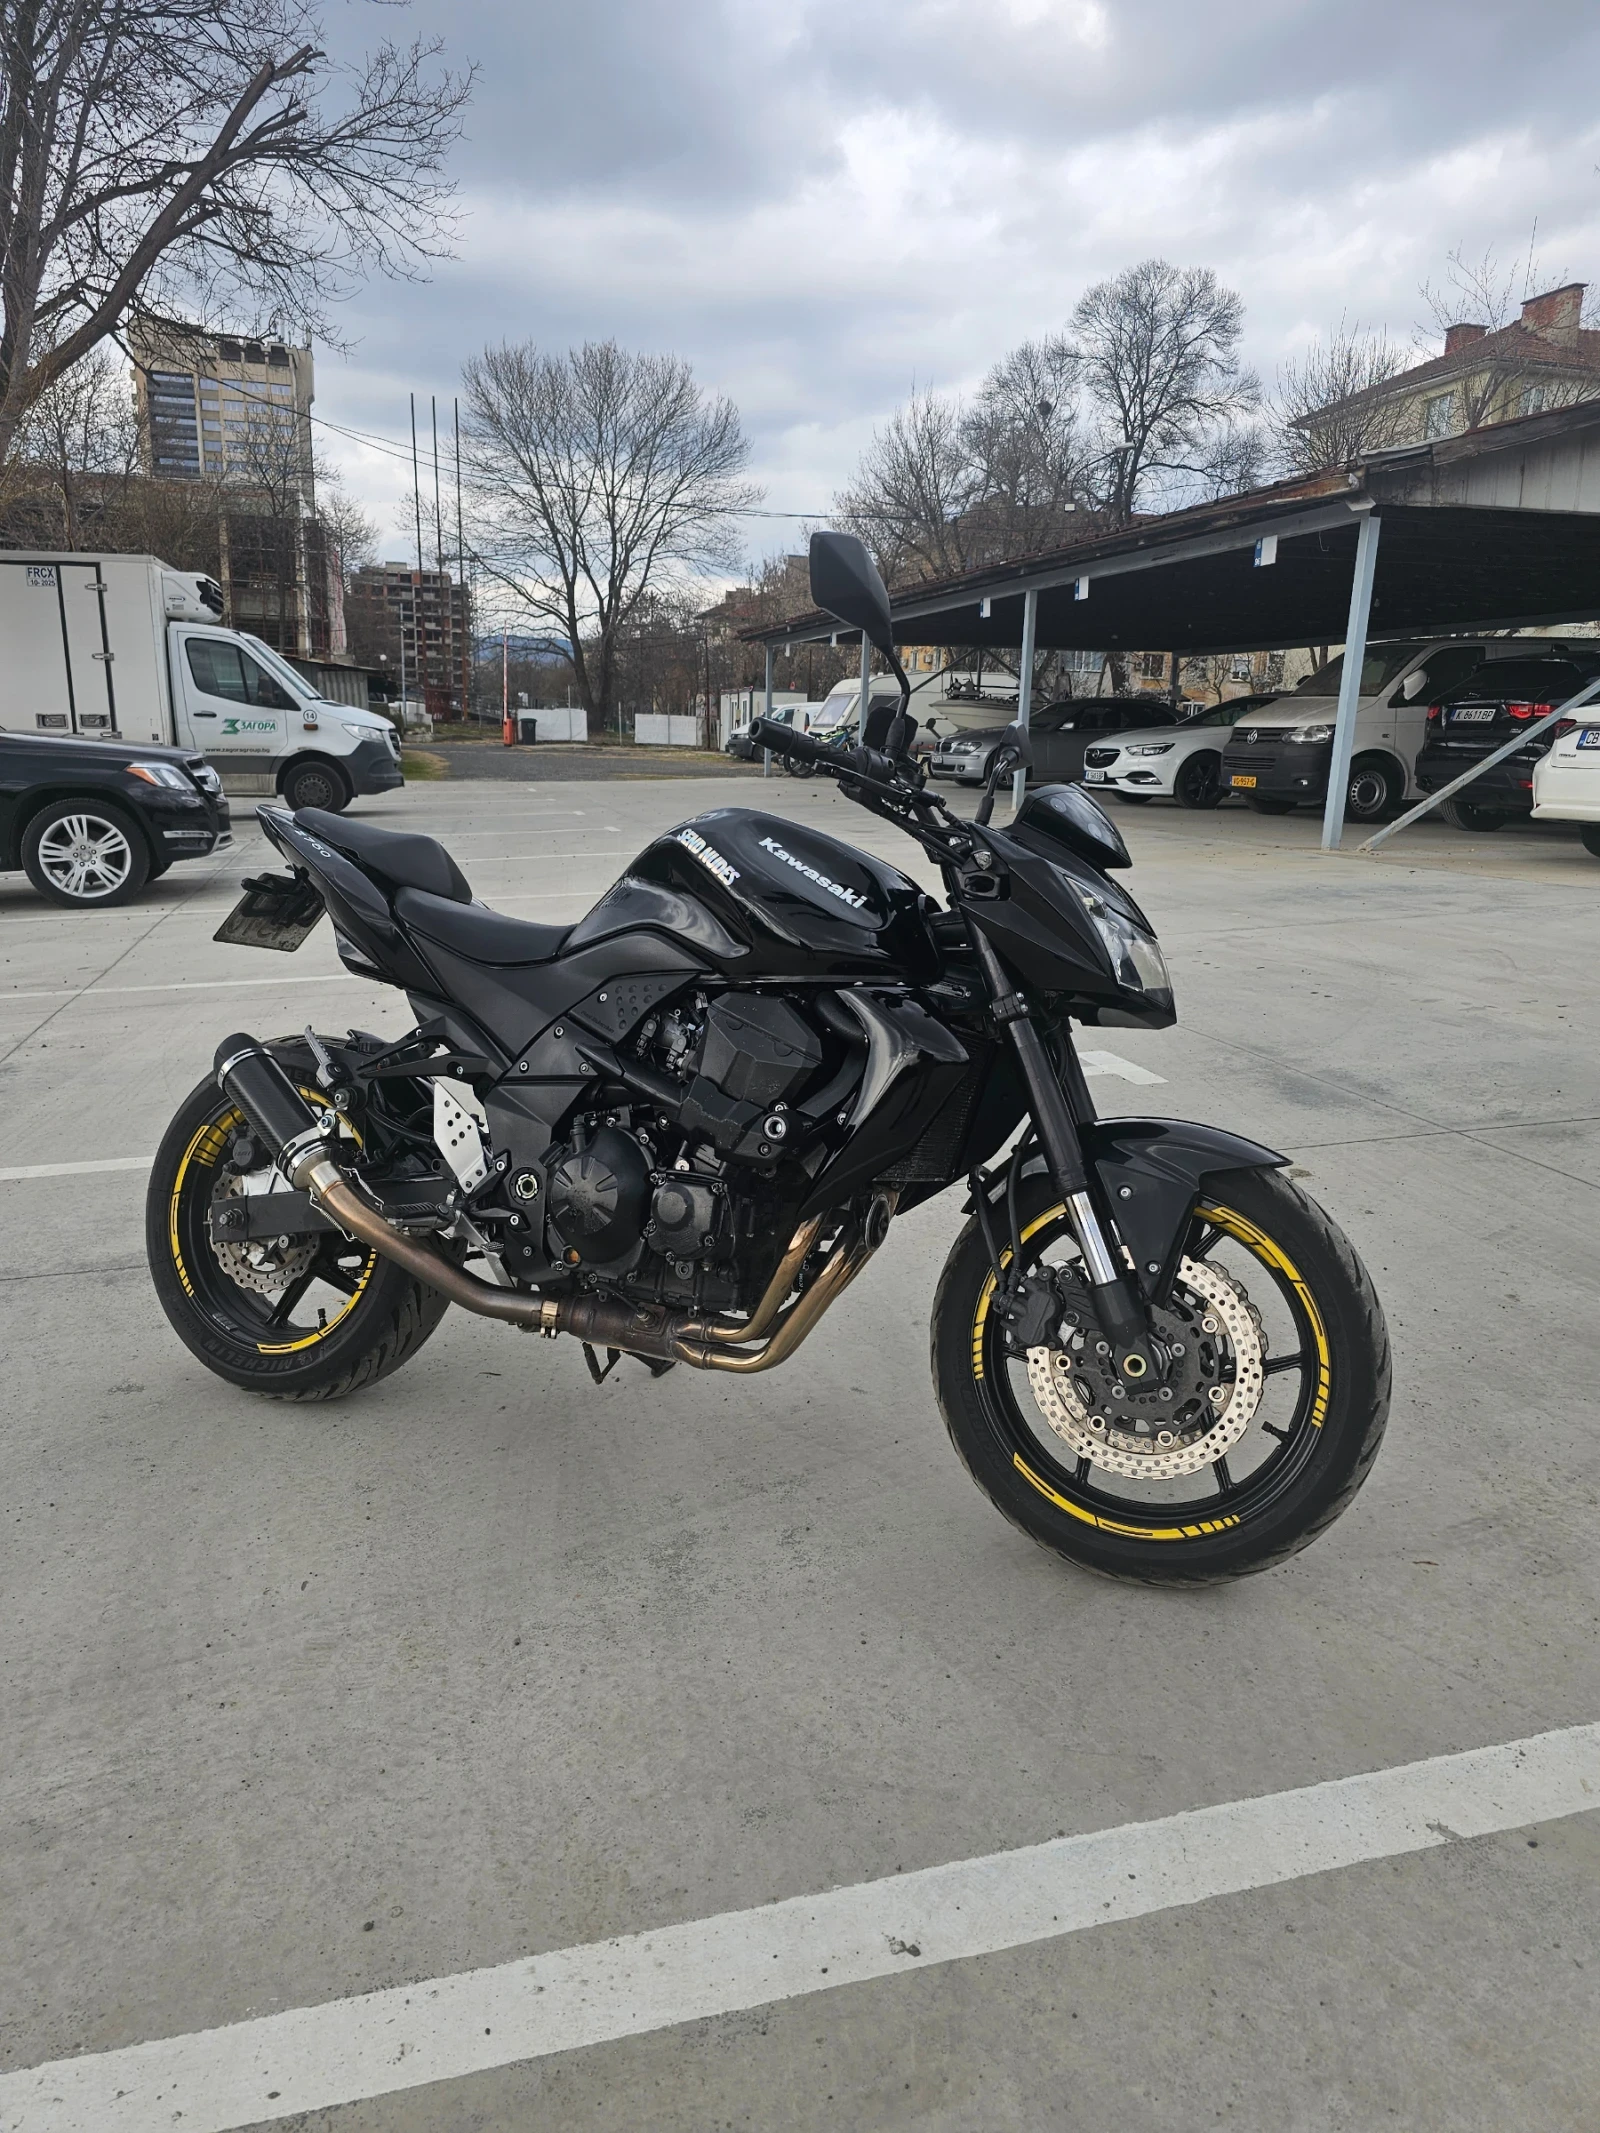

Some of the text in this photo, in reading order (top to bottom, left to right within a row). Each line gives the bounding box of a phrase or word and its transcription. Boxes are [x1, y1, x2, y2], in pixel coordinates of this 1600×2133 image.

[27, 567, 54, 578] FRCX
[241, 721, 276, 730] ЗАГОРА
[676, 828, 741, 885] SEND NUDES
[758, 837, 868, 909] Kawasaki
[203, 1338, 294, 1371] MICHELIN
